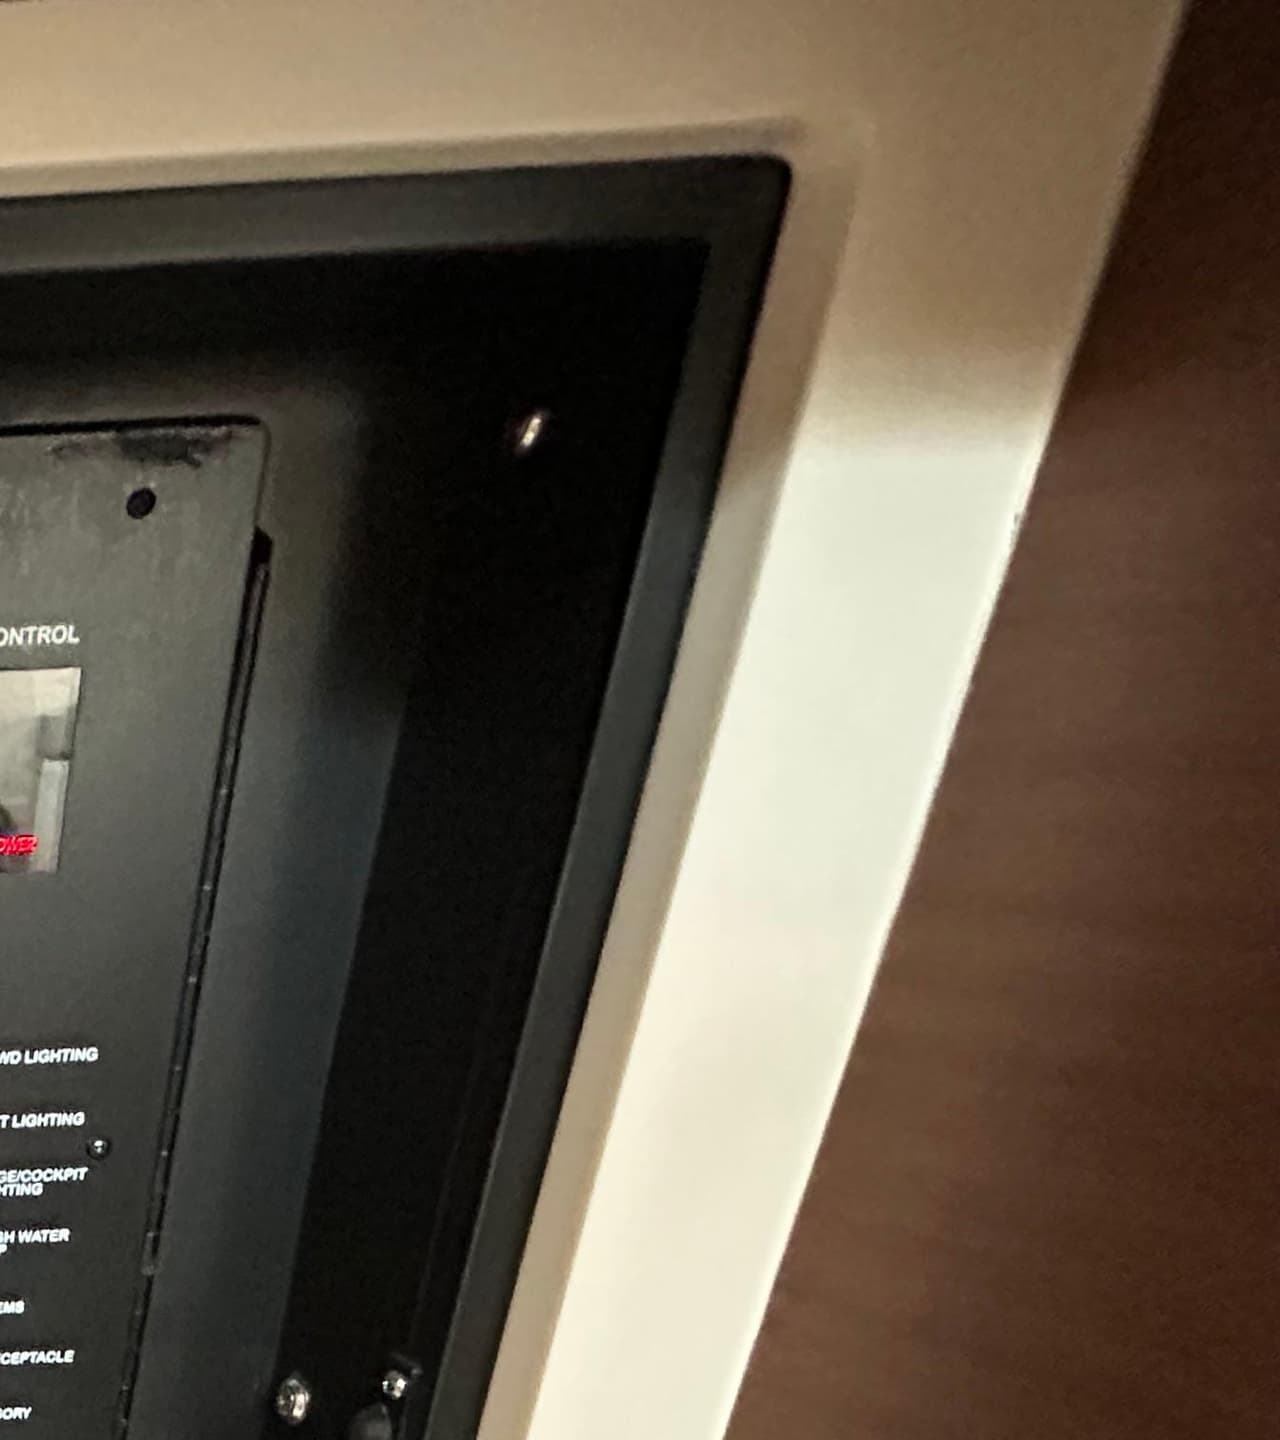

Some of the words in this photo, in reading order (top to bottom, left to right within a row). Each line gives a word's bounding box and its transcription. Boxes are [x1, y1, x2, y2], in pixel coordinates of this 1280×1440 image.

[24, 1047, 99, 1064] LIGHTING
[12, 1112, 85, 1128] LIGHTING
[18, 1229, 71, 1243] WATER
